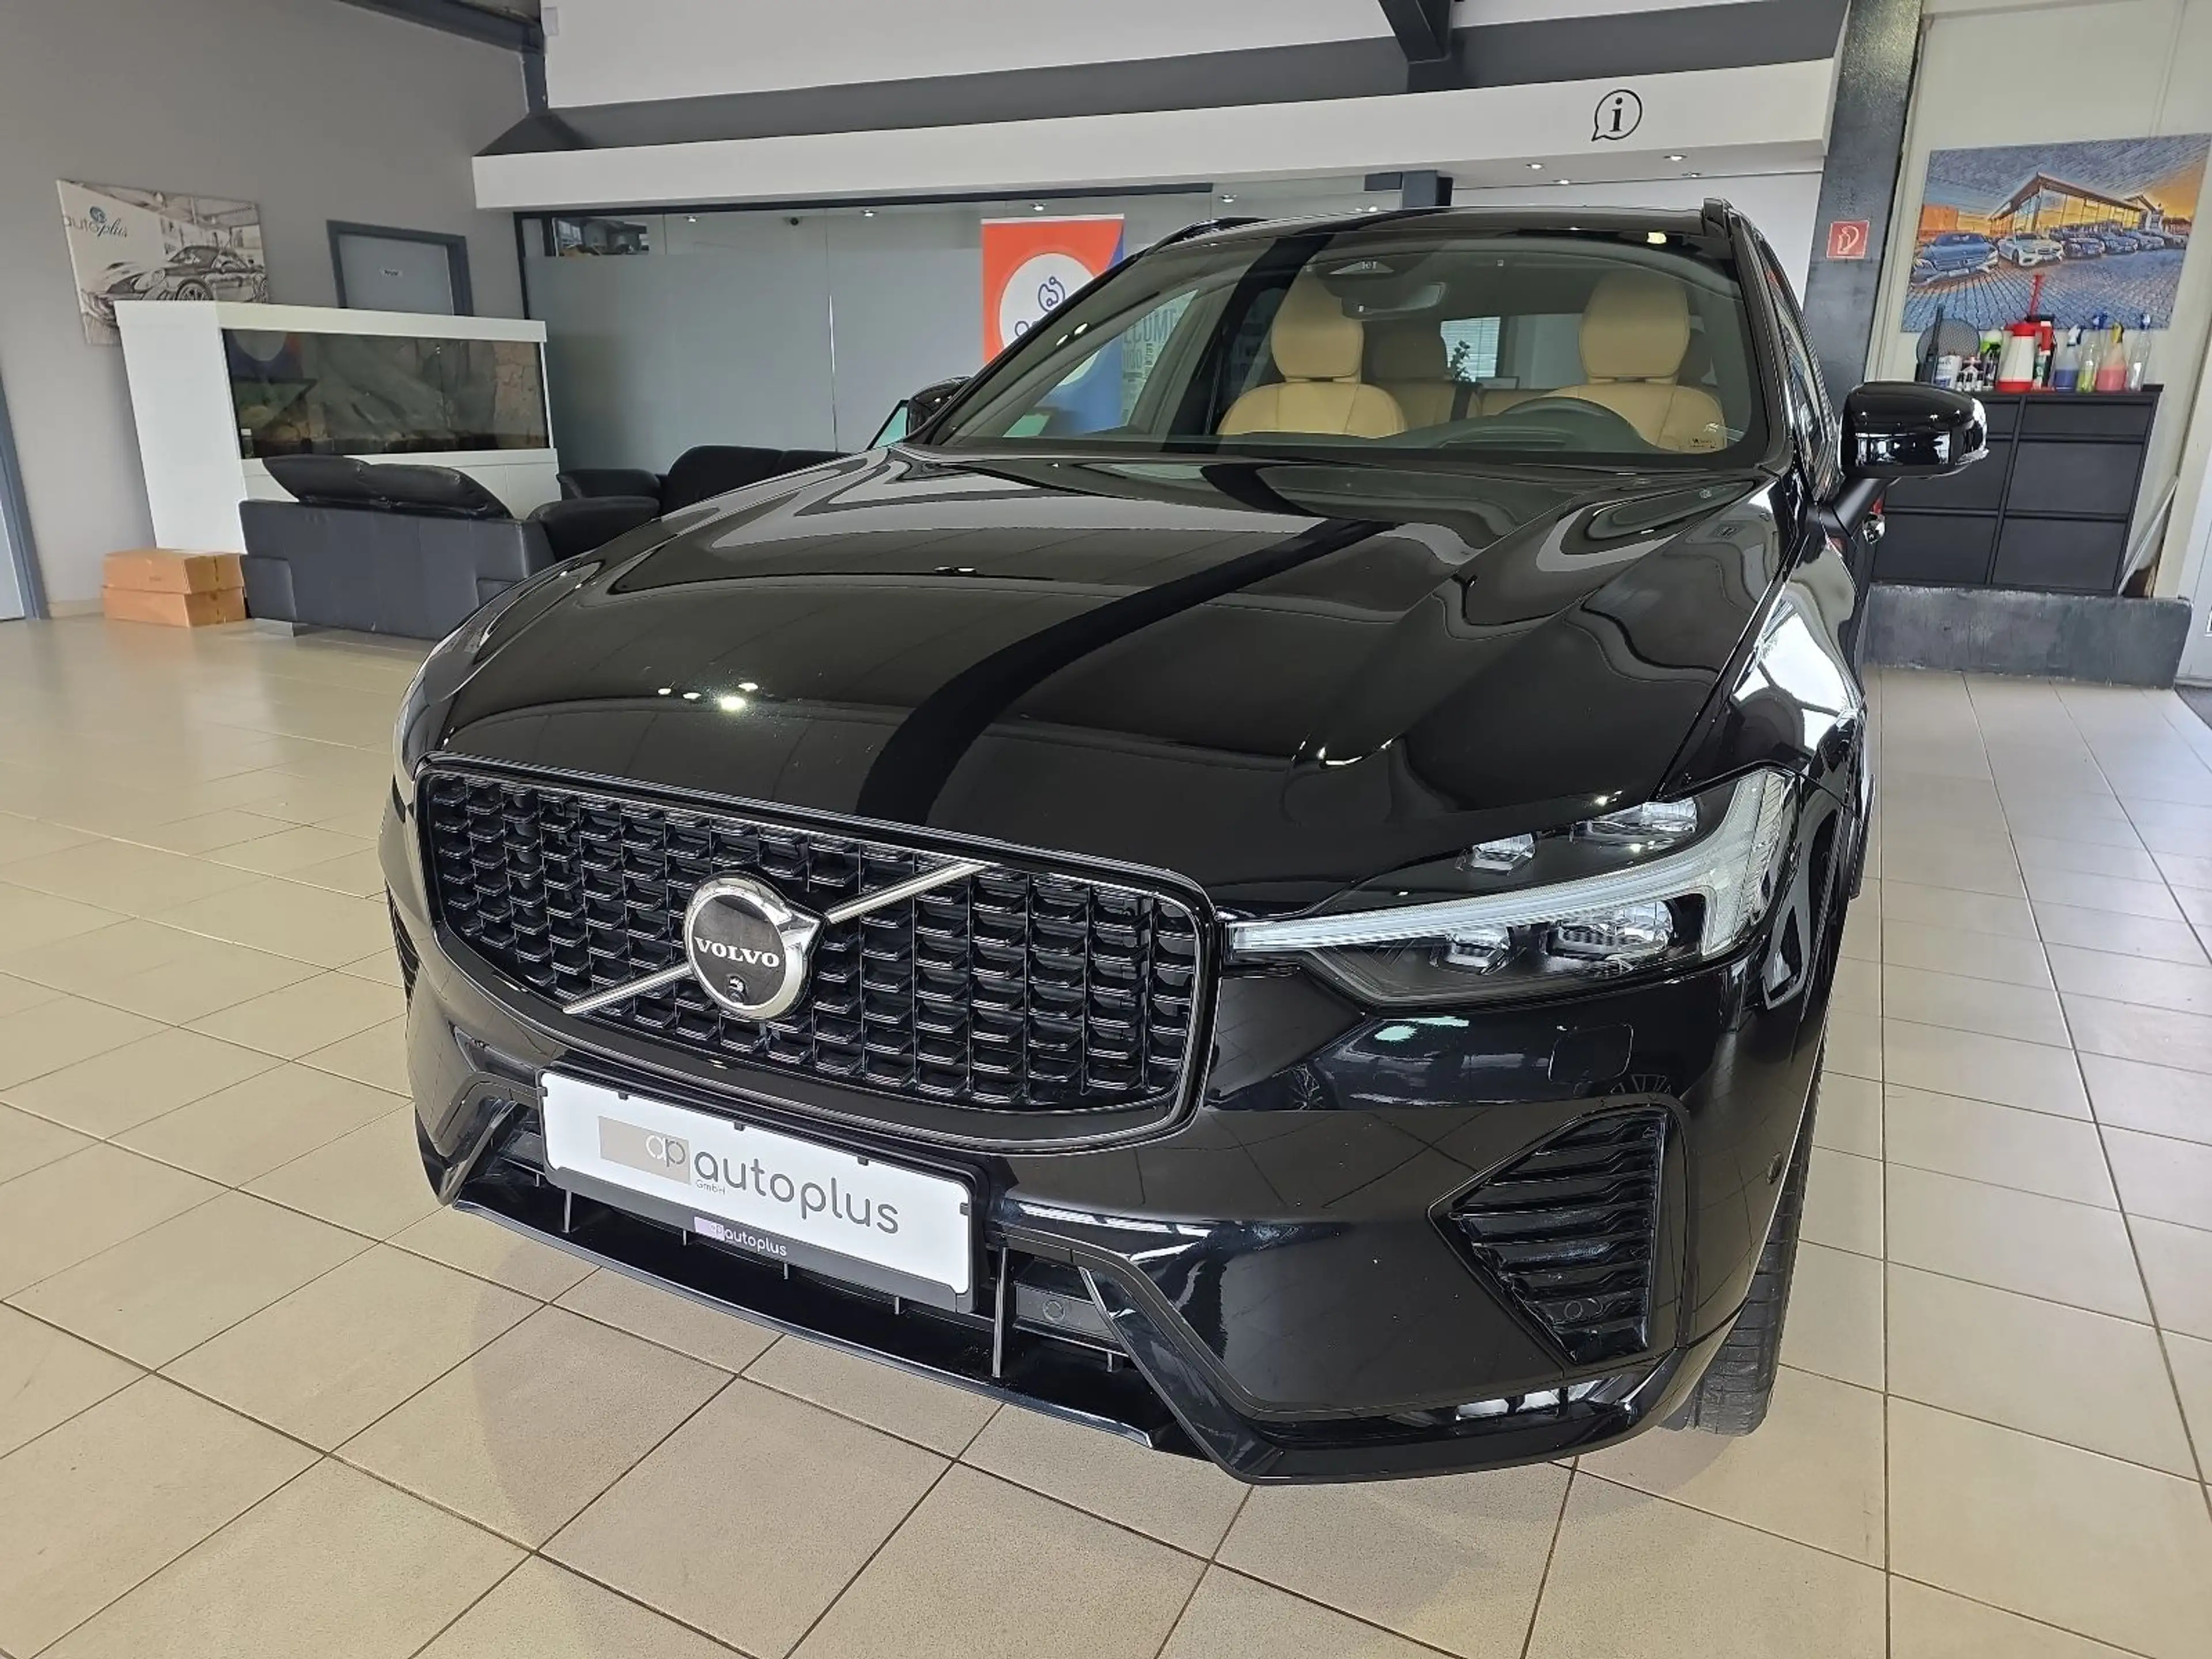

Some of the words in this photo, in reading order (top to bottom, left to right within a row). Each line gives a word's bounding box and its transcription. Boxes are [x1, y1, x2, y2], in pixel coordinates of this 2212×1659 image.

[694, 936, 779, 967] VOLVO
[694, 1152, 899, 1234] autoplus
[695, 1179, 726, 1196] GmbH
[724, 1228, 787, 1257] autoplus
